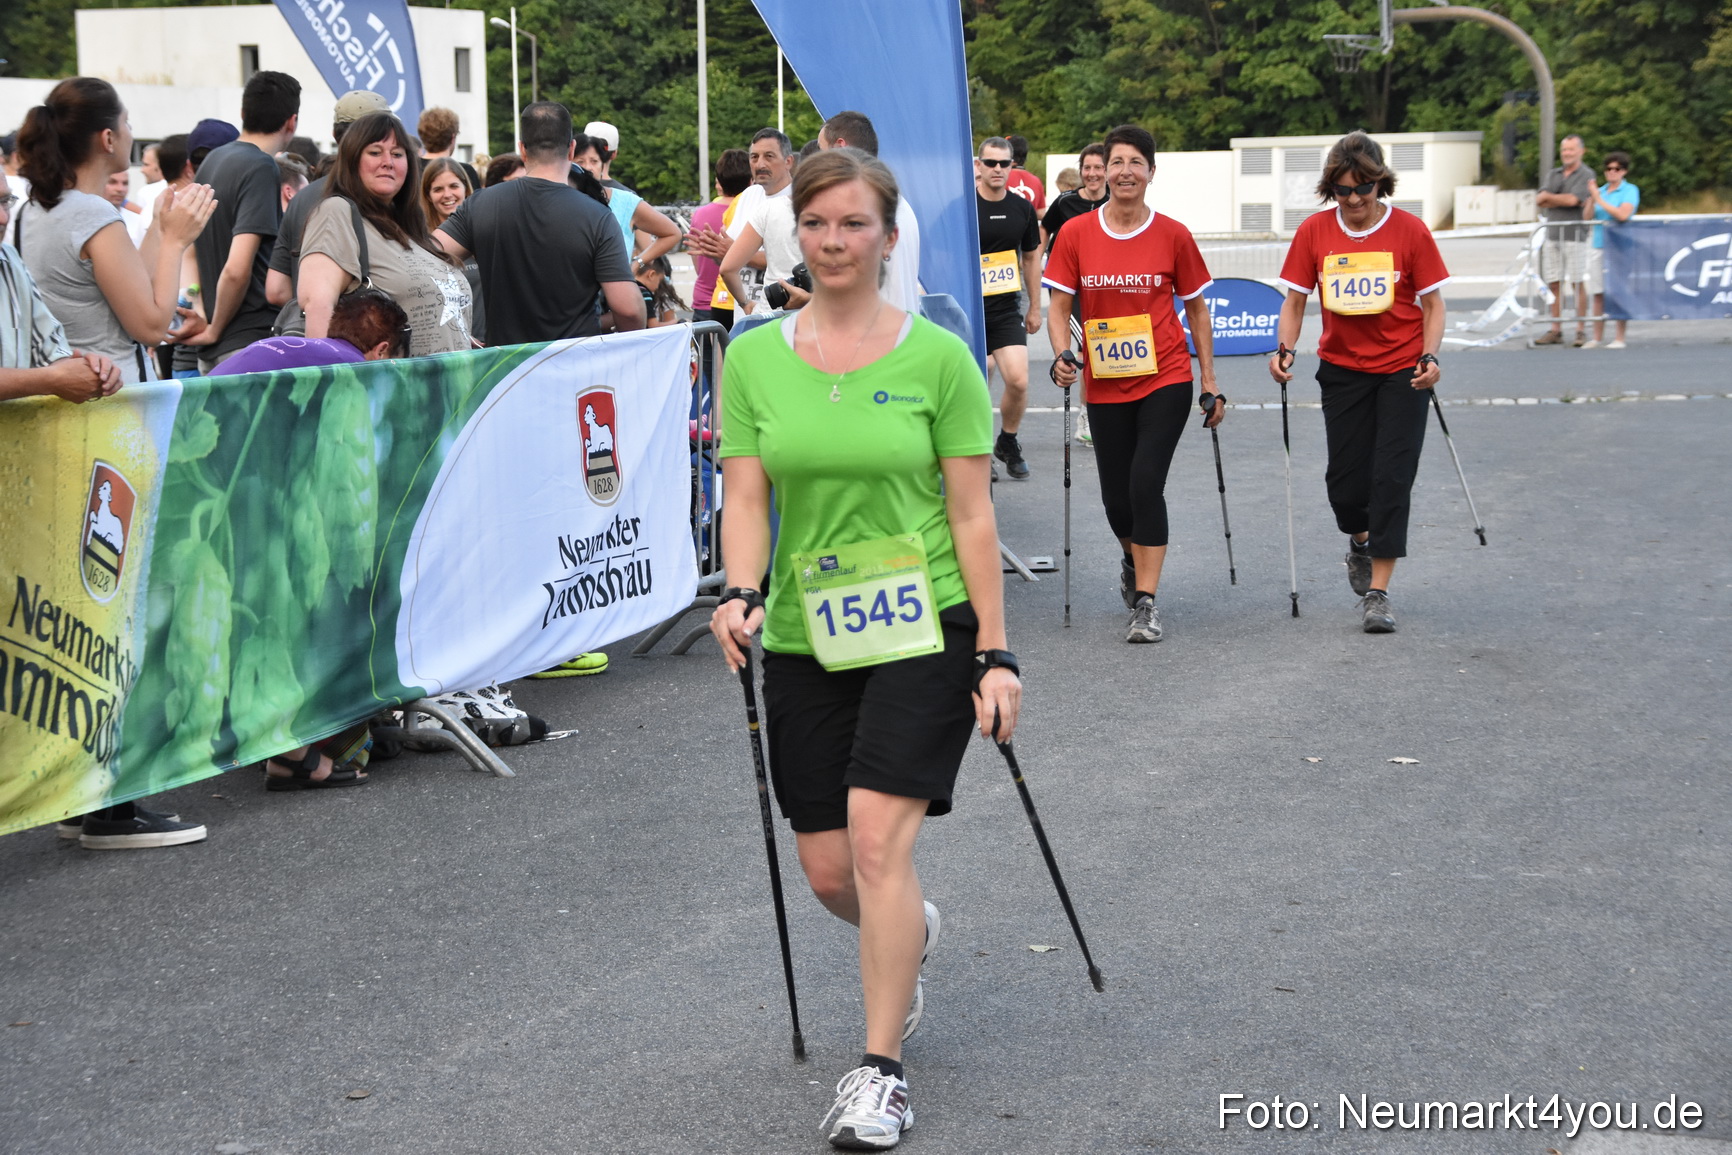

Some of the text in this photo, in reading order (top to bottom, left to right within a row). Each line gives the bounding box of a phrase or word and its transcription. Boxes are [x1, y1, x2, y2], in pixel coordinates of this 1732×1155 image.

[981, 267, 1015, 284] 1249
[1080, 274, 1153, 288] NEUMARKT
[1697, 259, 1732, 289] Fi
[1330, 276, 1387, 298] 1405
[1210, 301, 1279, 329] ischer
[1213, 328, 1274, 338] UTOMOBILE
[1095, 340, 1148, 362] 1406
[593, 476, 614, 495] 1628
[86, 563, 110, 593] 1628
[816, 583, 923, 637] 1545
